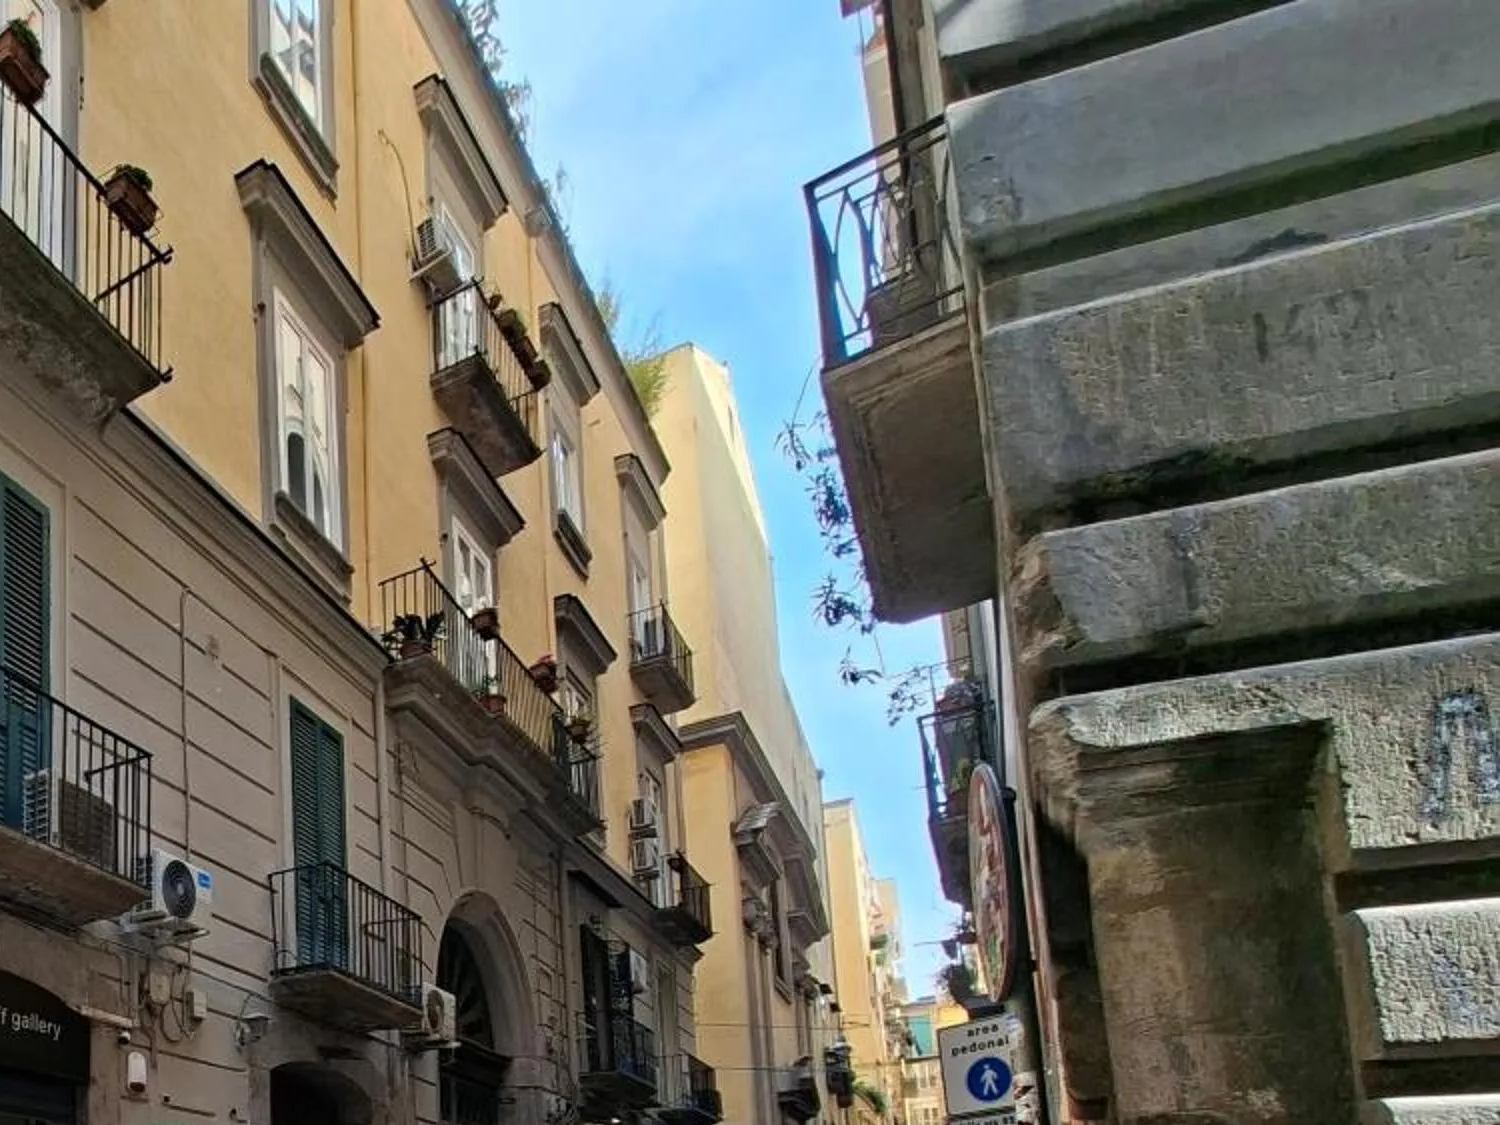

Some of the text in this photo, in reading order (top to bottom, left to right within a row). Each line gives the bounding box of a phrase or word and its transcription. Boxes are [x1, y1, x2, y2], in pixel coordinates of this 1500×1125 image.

[11, 1012, 61, 1041] gallery
[967, 1023, 999, 1037] area
[951, 1034, 1010, 1057] pedonal
